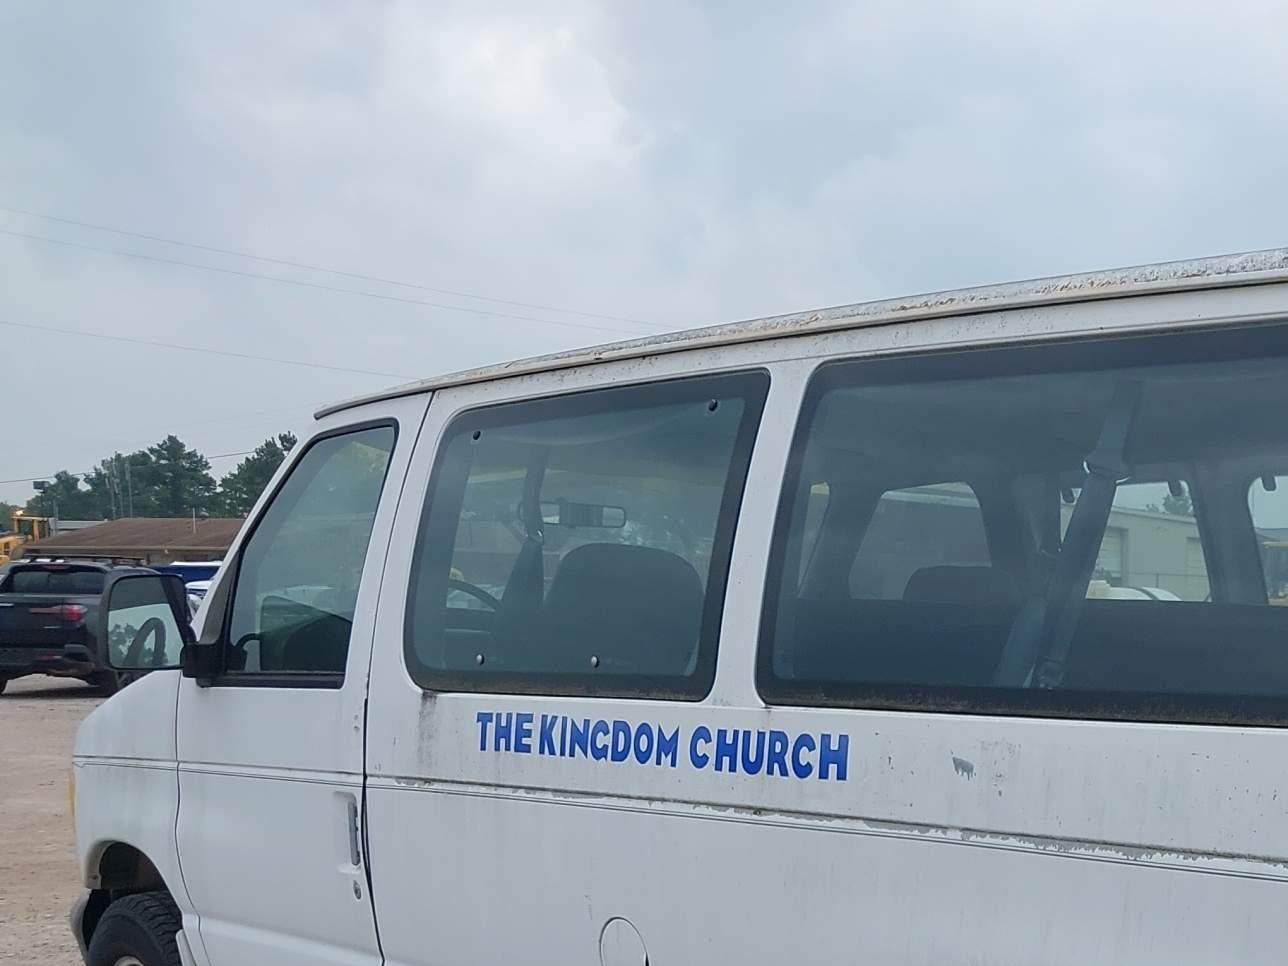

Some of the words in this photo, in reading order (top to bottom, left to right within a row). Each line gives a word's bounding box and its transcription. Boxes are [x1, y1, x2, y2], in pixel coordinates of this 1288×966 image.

[476, 711, 534, 753] THE
[538, 714, 680, 768] KINGDOM
[689, 725, 850, 782] CHURCH
